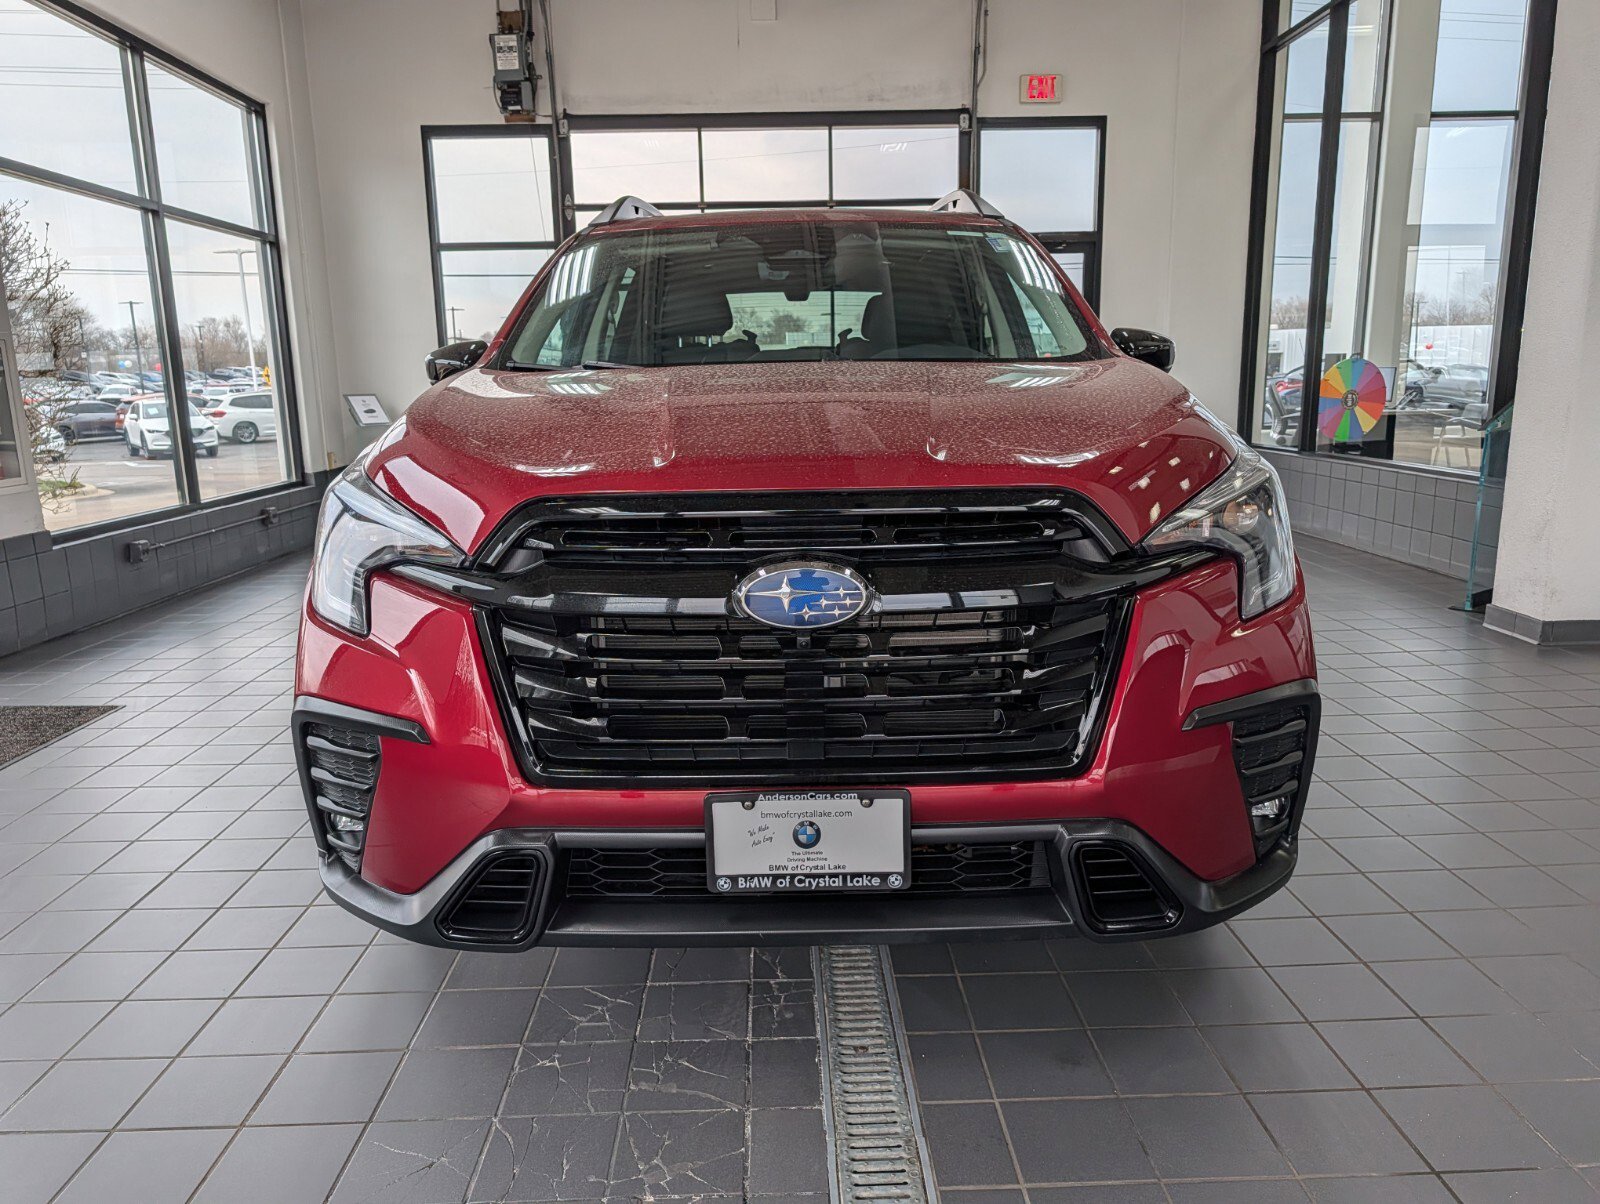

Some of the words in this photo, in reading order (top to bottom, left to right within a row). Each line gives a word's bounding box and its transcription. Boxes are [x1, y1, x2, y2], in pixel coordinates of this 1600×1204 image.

[1028, 75, 1056, 99] EXIT
[758, 792, 858, 801] AndersonCars.com
[760, 809, 852, 820] bmwofcrystallake.com
[800, 864, 826, 872] Crystal
[738, 876, 772, 889] BMW
[776, 875, 791, 888] of
[794, 875, 842, 889] Crystal
[846, 874, 881, 887] Lake
